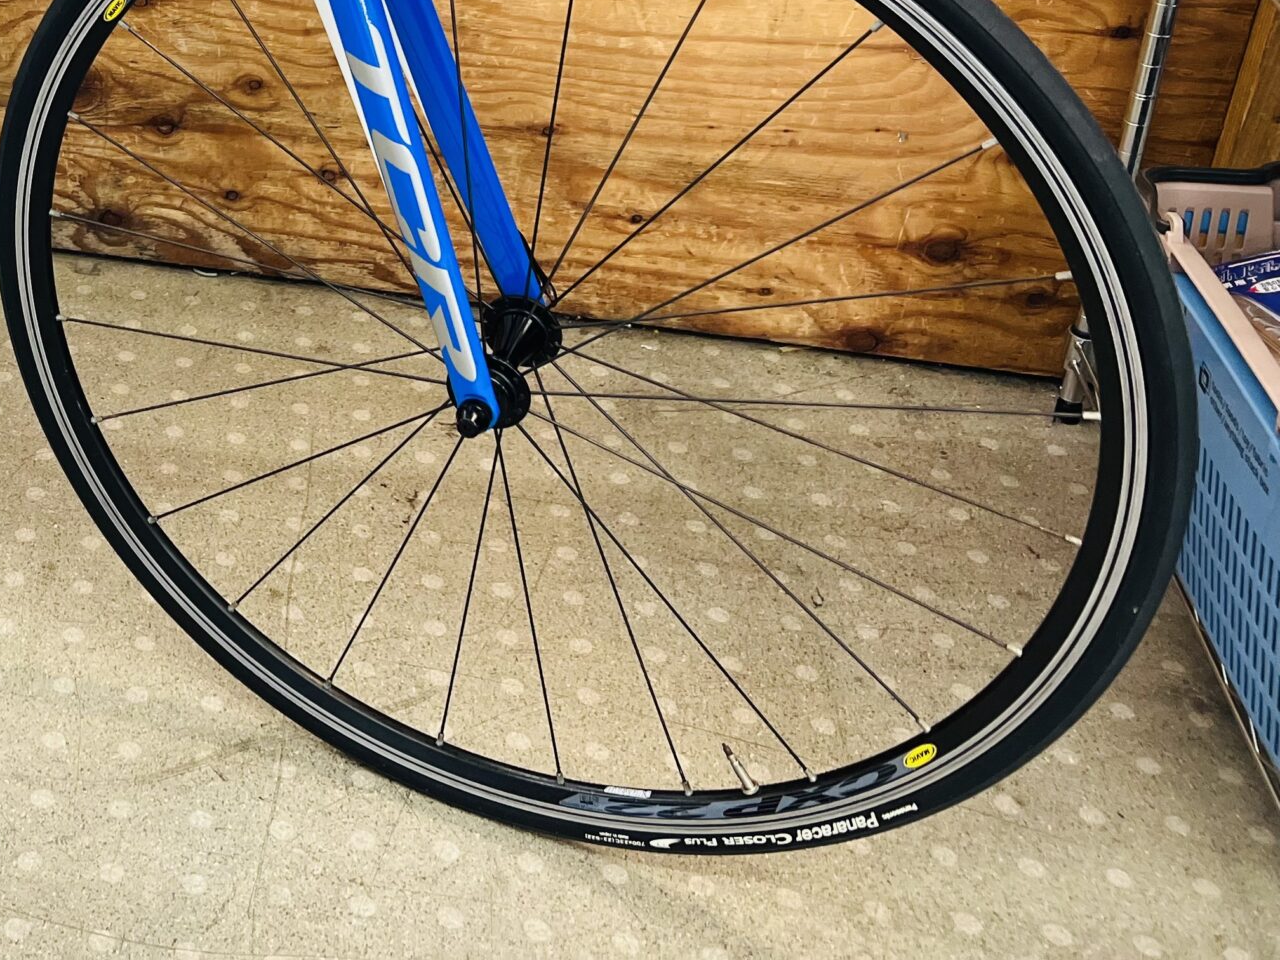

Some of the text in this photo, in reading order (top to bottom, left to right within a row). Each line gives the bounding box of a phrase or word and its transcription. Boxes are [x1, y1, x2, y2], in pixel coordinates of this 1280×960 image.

[346, 22, 477, 382] TCR
[909, 747, 931, 764] MAVIC
[796, 811, 880, 841] Panaracer
[684, 836, 719, 847] PLUS
[724, 832, 793, 846] CLOSER
